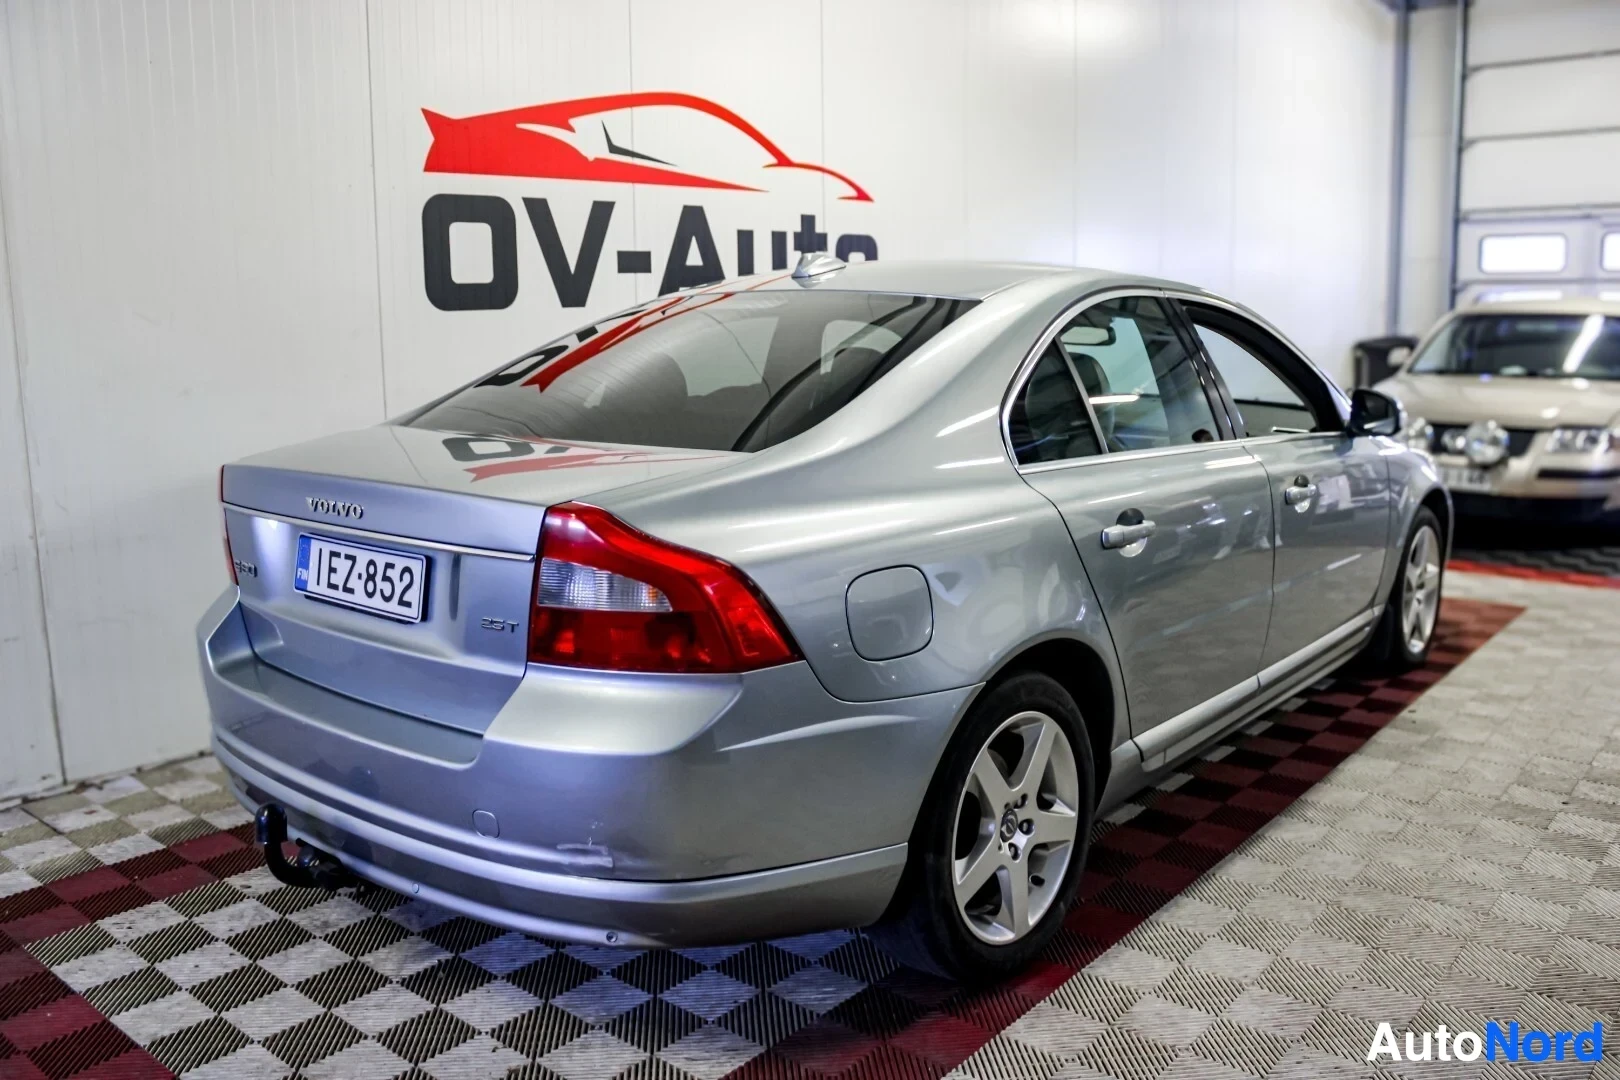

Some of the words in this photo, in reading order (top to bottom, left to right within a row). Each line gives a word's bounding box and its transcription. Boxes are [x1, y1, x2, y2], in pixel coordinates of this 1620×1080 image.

[305, 496, 364, 520] VOLVO
[297, 567, 309, 581] FIN
[316, 547, 415, 609] IEZ-852
